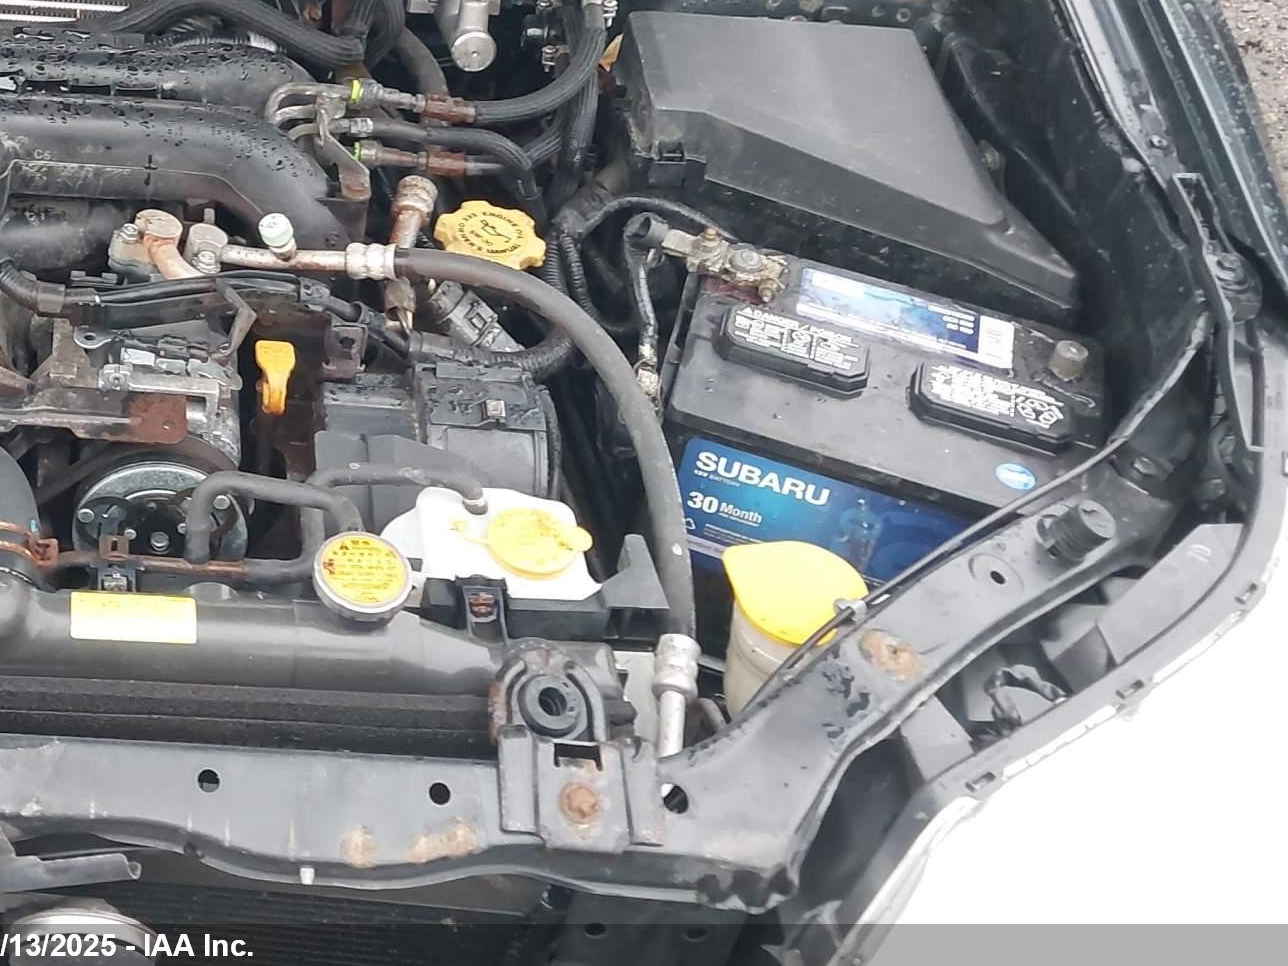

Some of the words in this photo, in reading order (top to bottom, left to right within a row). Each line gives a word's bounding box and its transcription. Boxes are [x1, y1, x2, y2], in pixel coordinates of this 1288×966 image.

[695, 451, 831, 506] SUBARU
[687, 491, 719, 514] 30
[719, 501, 763, 524] Month
